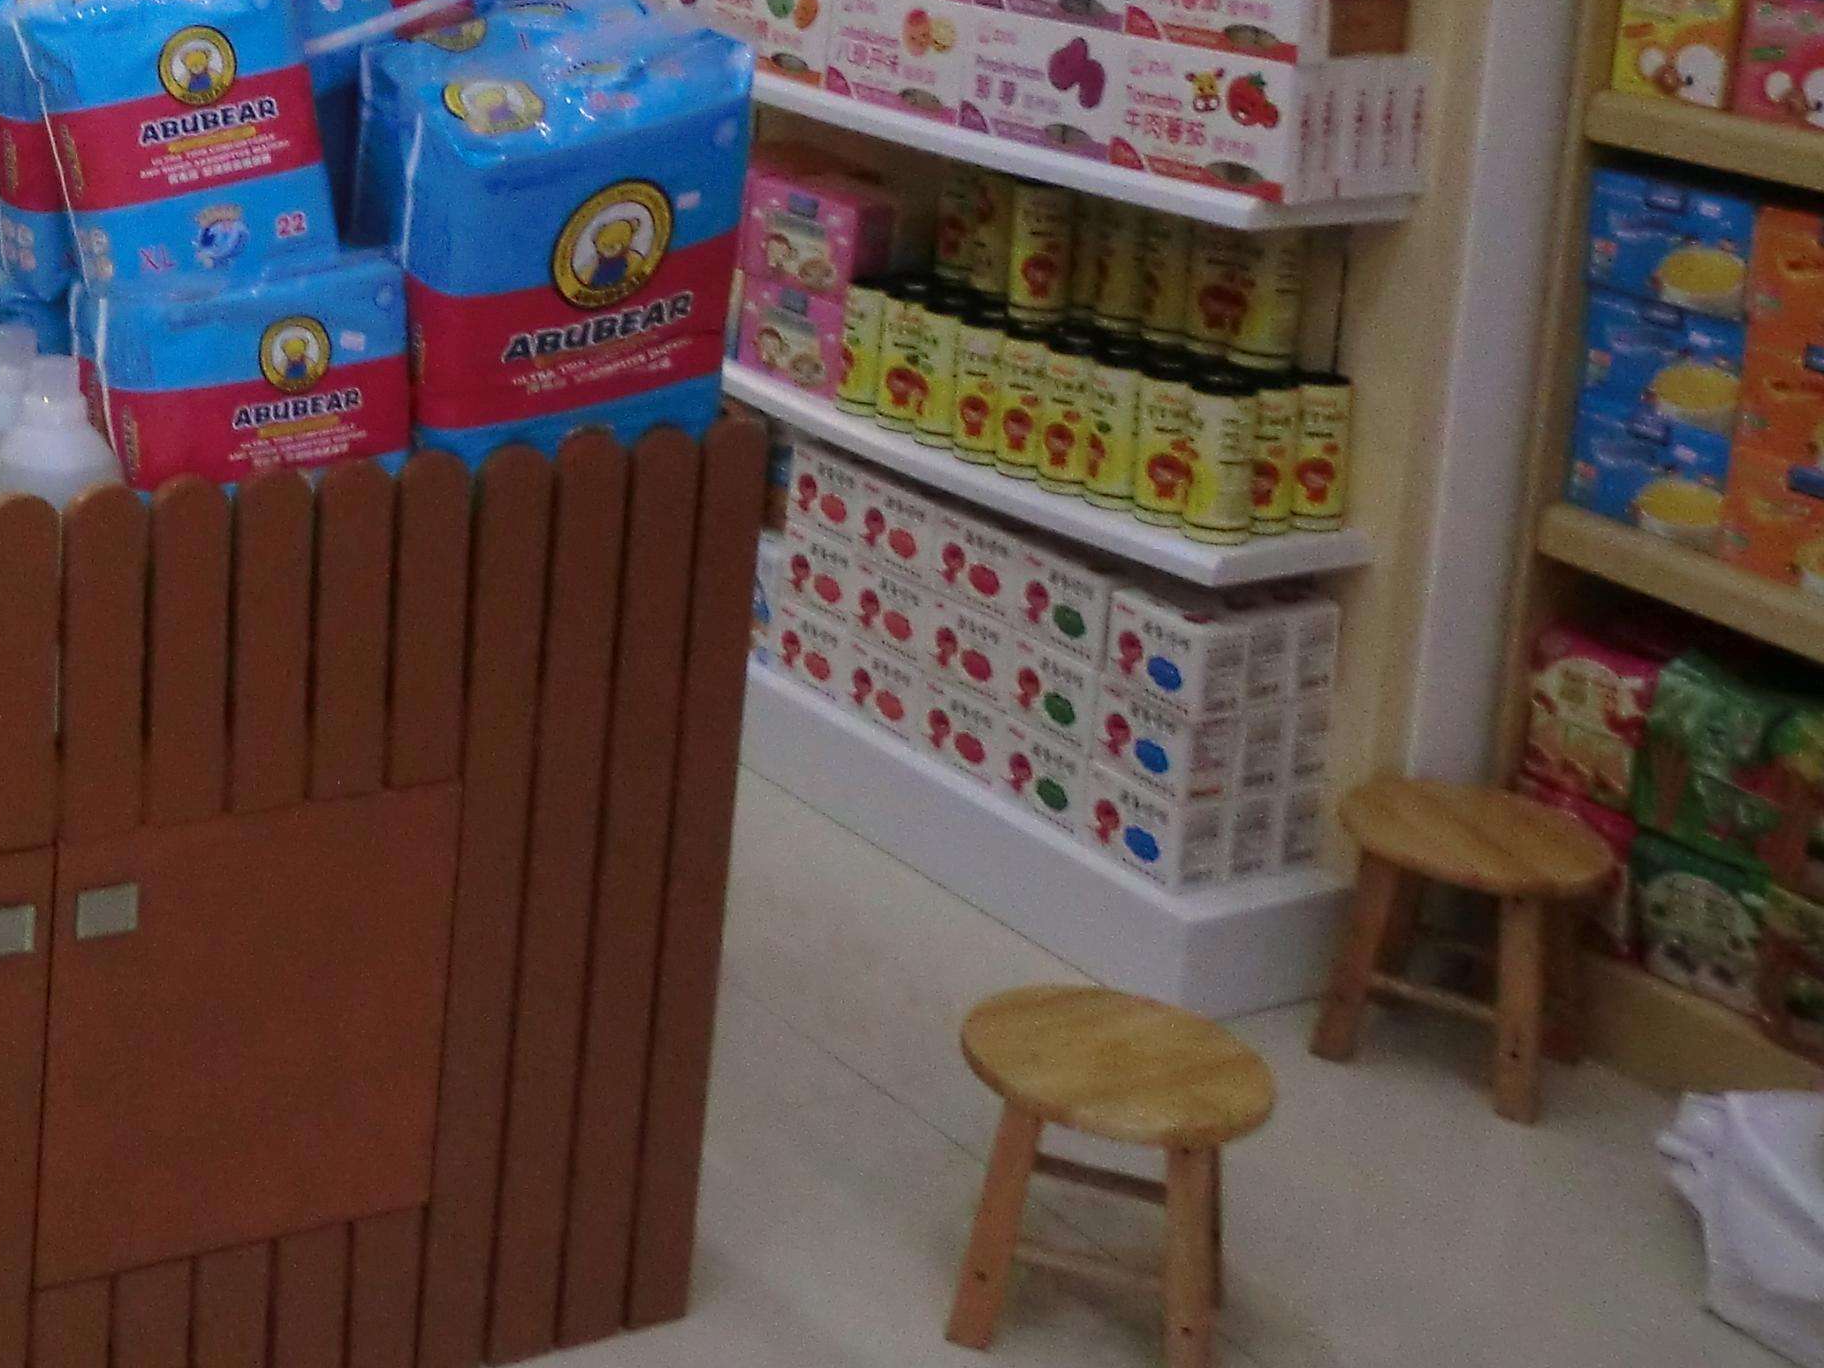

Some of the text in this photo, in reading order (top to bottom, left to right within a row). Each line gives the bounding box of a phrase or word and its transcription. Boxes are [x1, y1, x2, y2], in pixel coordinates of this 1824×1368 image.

[138, 96, 280, 146] ABUBEAR
[501, 290, 694, 364] ABUBEAR
[232, 387, 363, 430] ABUBEAR
